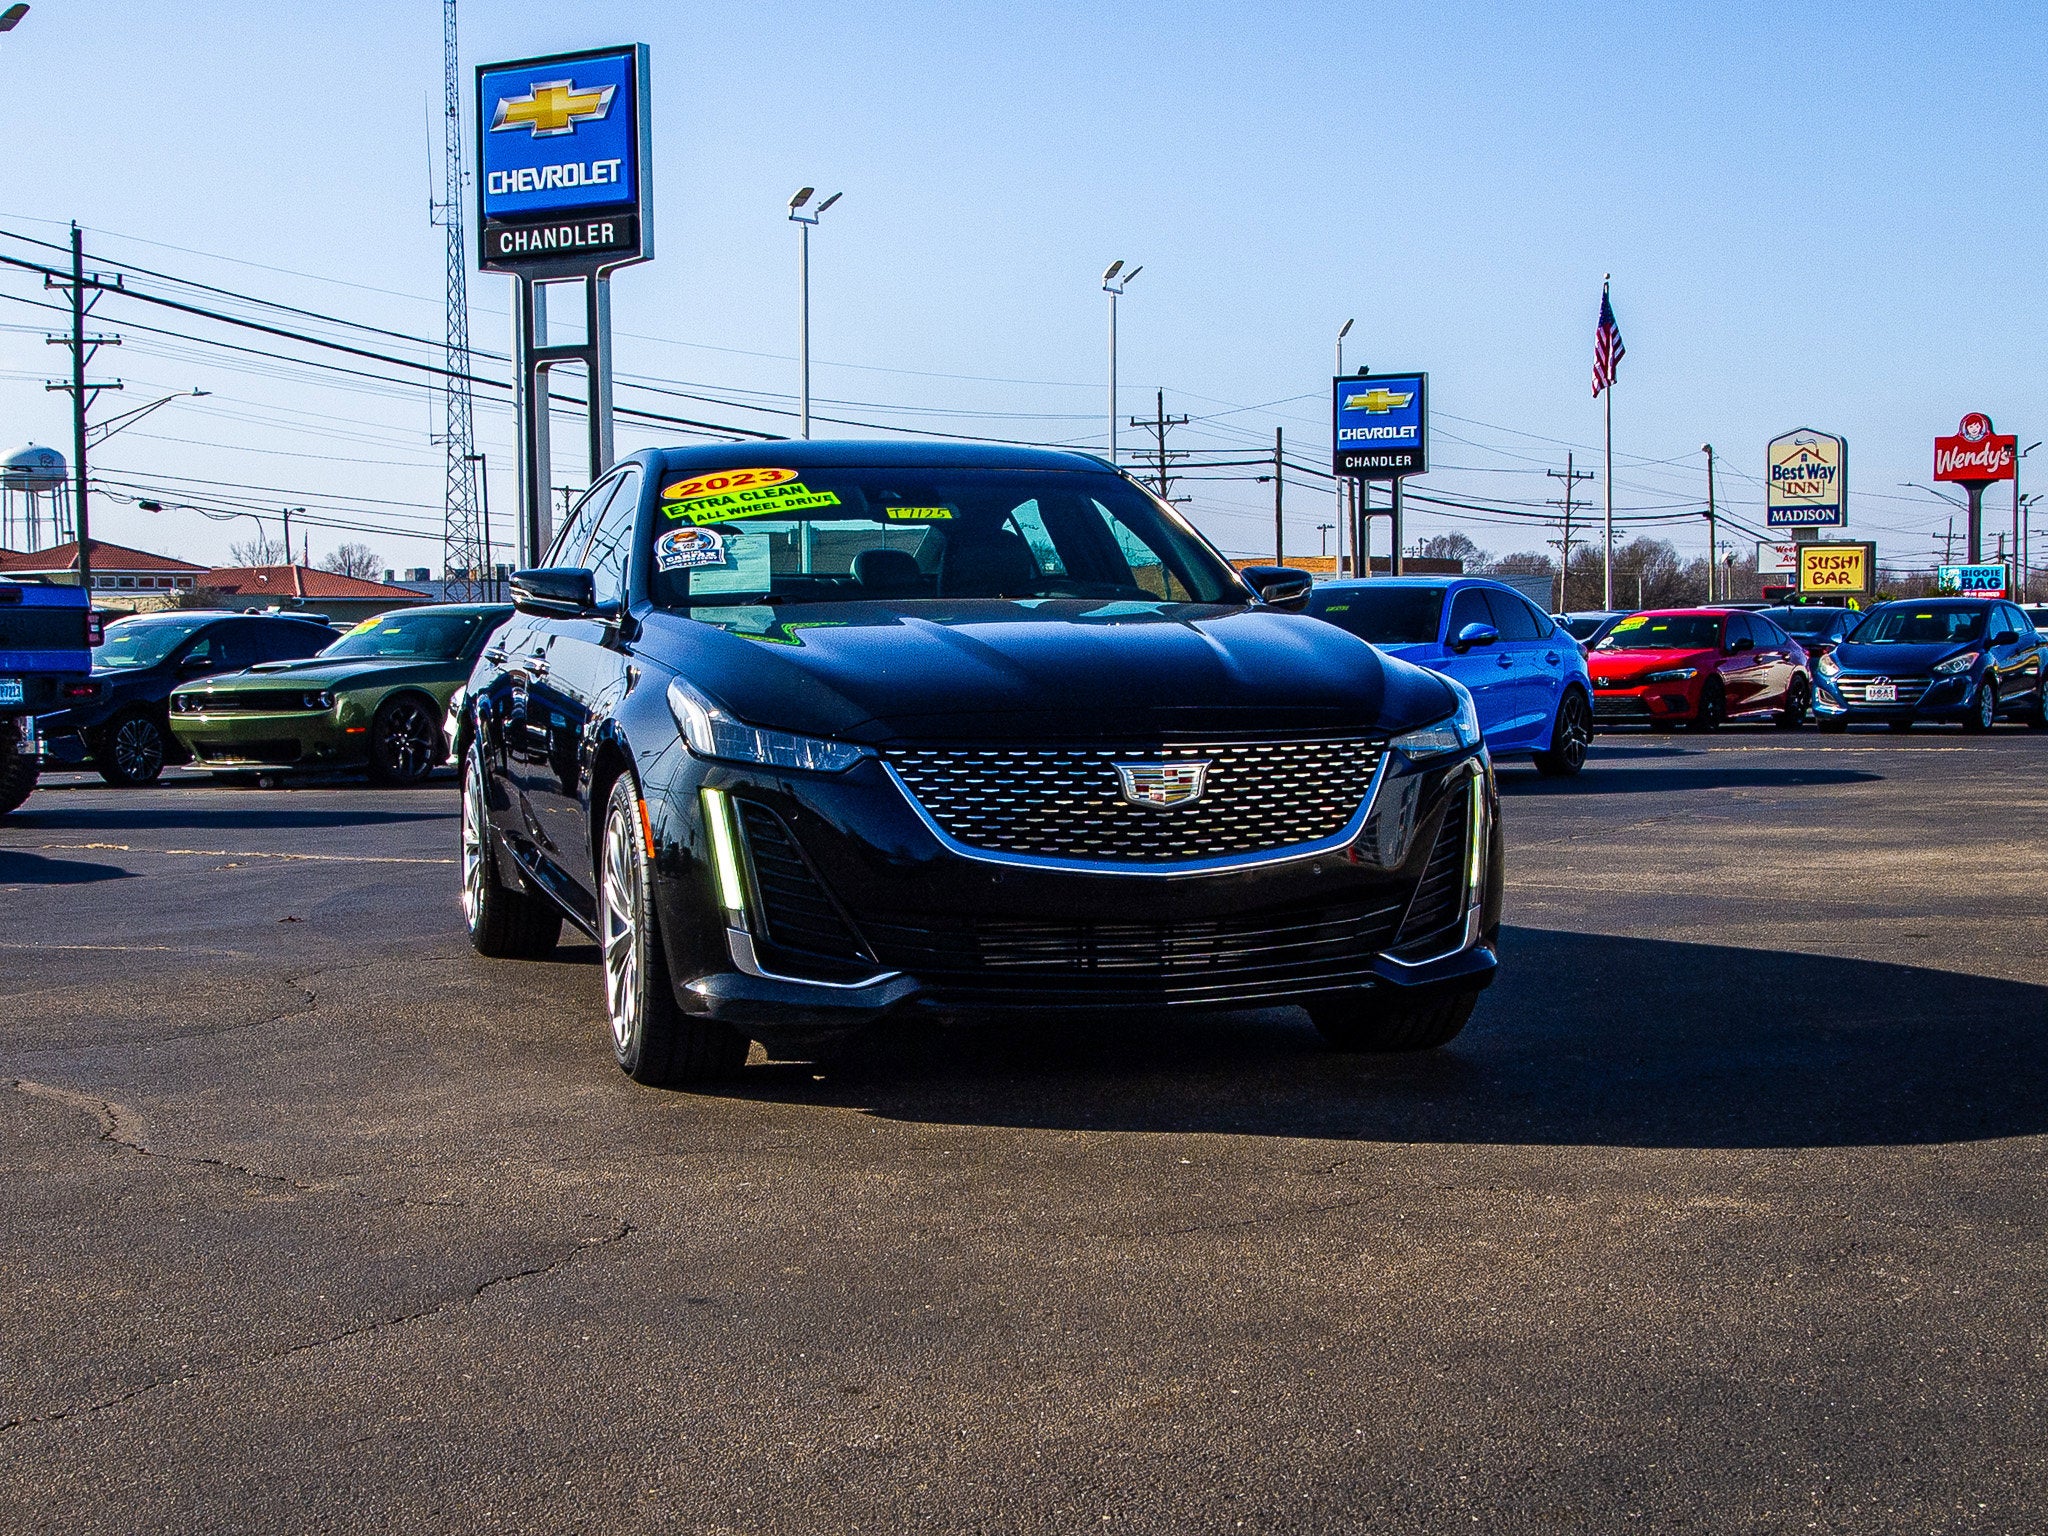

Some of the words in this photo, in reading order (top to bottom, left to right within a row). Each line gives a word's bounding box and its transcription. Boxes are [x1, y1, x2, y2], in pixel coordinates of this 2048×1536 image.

[488, 159, 621, 194] CHEVROLET
[500, 222, 614, 253] CHANDLER
[1340, 426, 1417, 440] CHEVROLET
[1345, 456, 1412, 468] CHANDLER
[1937, 442, 2010, 475] Wendy's
[1772, 464, 1804, 480] Best
[1805, 463, 1836, 484] Way
[680, 470, 783, 497] 2023
[1786, 481, 1820, 494] INN
[668, 495, 735, 516] EXTRA
[739, 485, 804, 501] CLEAN
[696, 512, 725, 522] ALL
[726, 502, 781, 515] WHEEL
[786, 494, 834, 507] DRIVE
[1771, 509, 1835, 522] MADISON
[1807, 556, 1860, 570] SUSHI
[1812, 572, 1851, 585] BAR
[1961, 569, 2000, 577] BIGGIE
[1961, 578, 2001, 589] BAG
